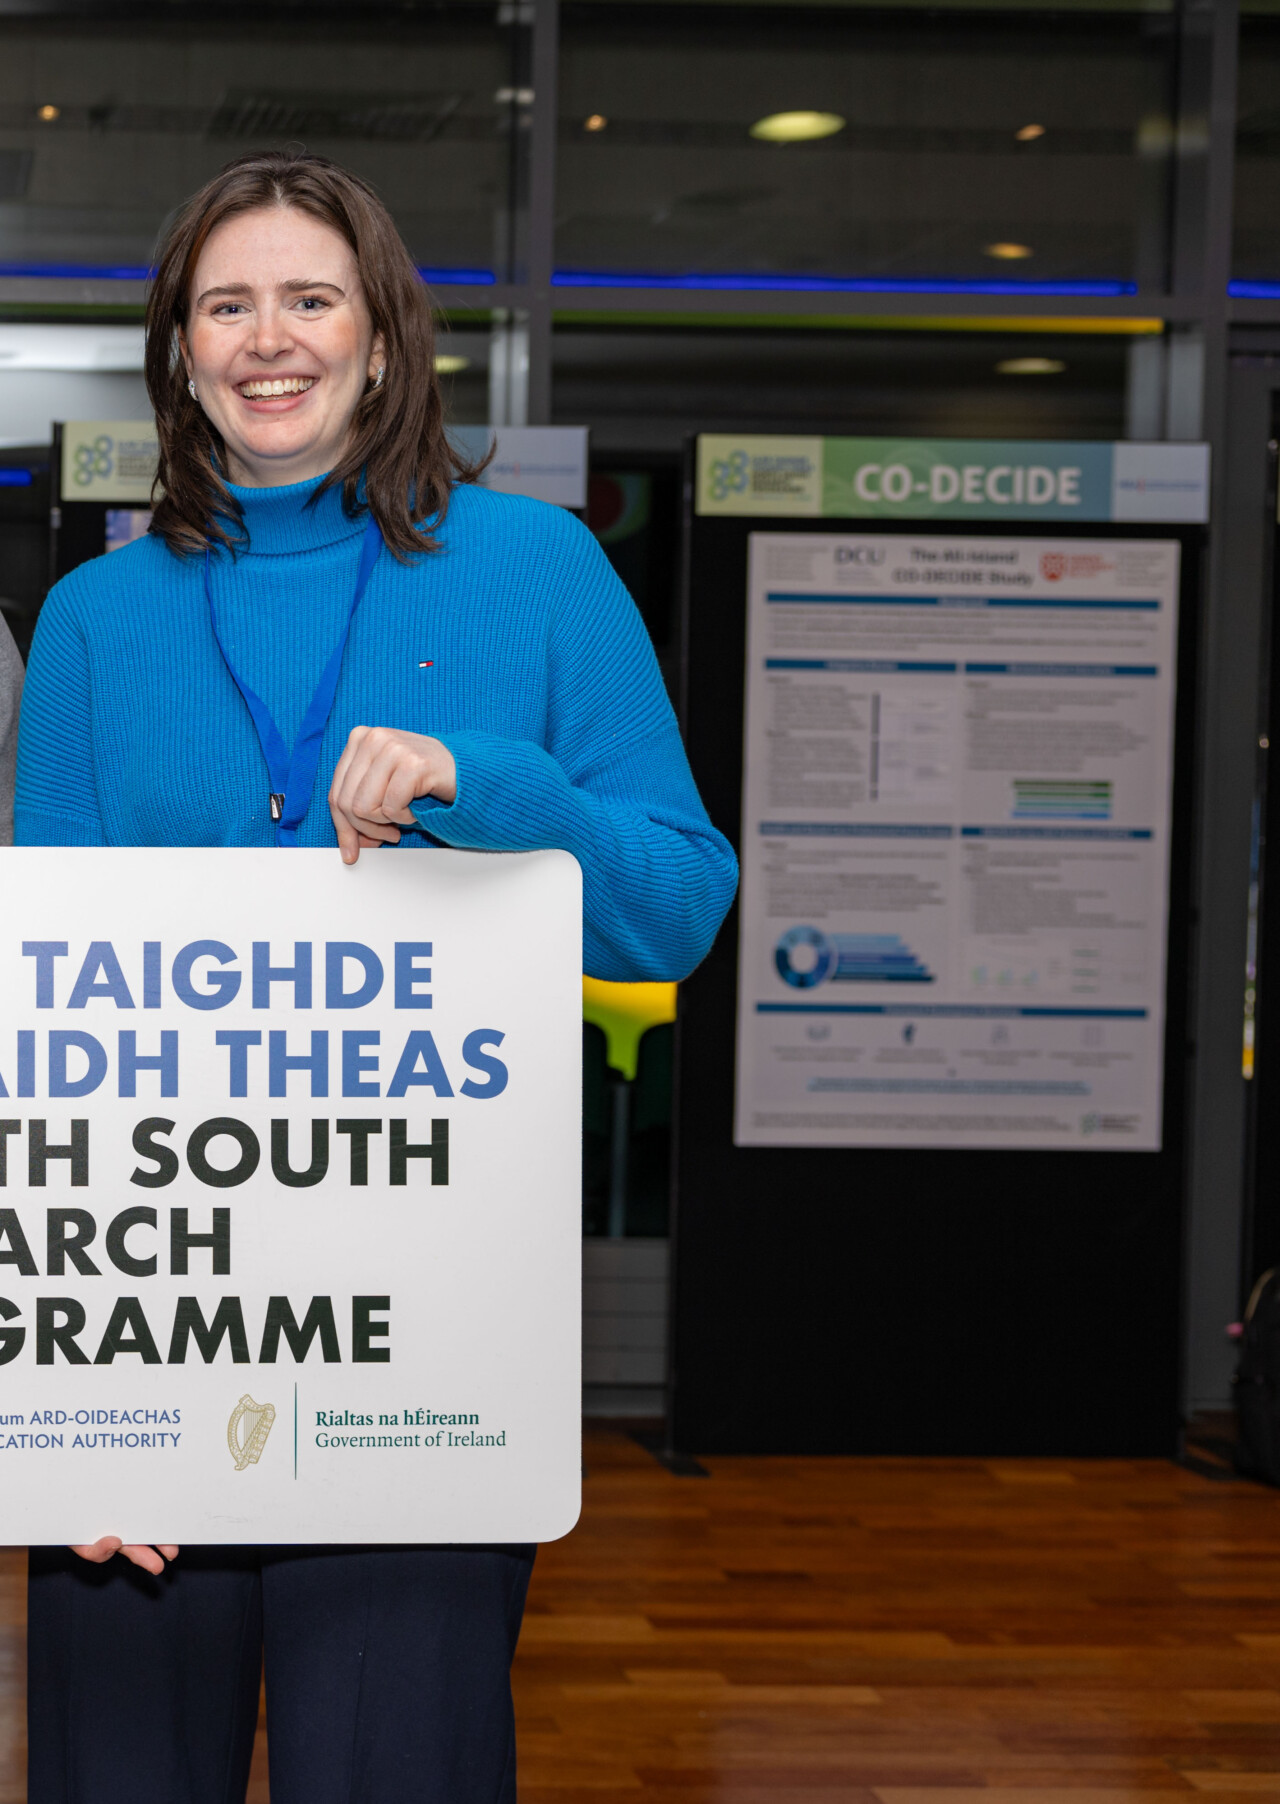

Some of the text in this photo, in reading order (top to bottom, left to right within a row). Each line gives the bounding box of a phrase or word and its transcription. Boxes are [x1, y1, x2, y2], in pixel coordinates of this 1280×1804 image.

[853, 463, 1081, 505] CO-DECIDE
[22, 940, 433, 1011] TAIGHDE
[215, 1028, 509, 1100] THEAS
[129, 1116, 450, 1189] SOUTH
[0, 1414, 25, 1426] um
[30, 1409, 181, 1426] ARD-OIDEACHAS
[315, 1408, 480, 1428] Rialtas na hÉireann
[72, 1432, 182, 1449] AUTHORITY
[315, 1430, 507, 1448] Government of Ireland
